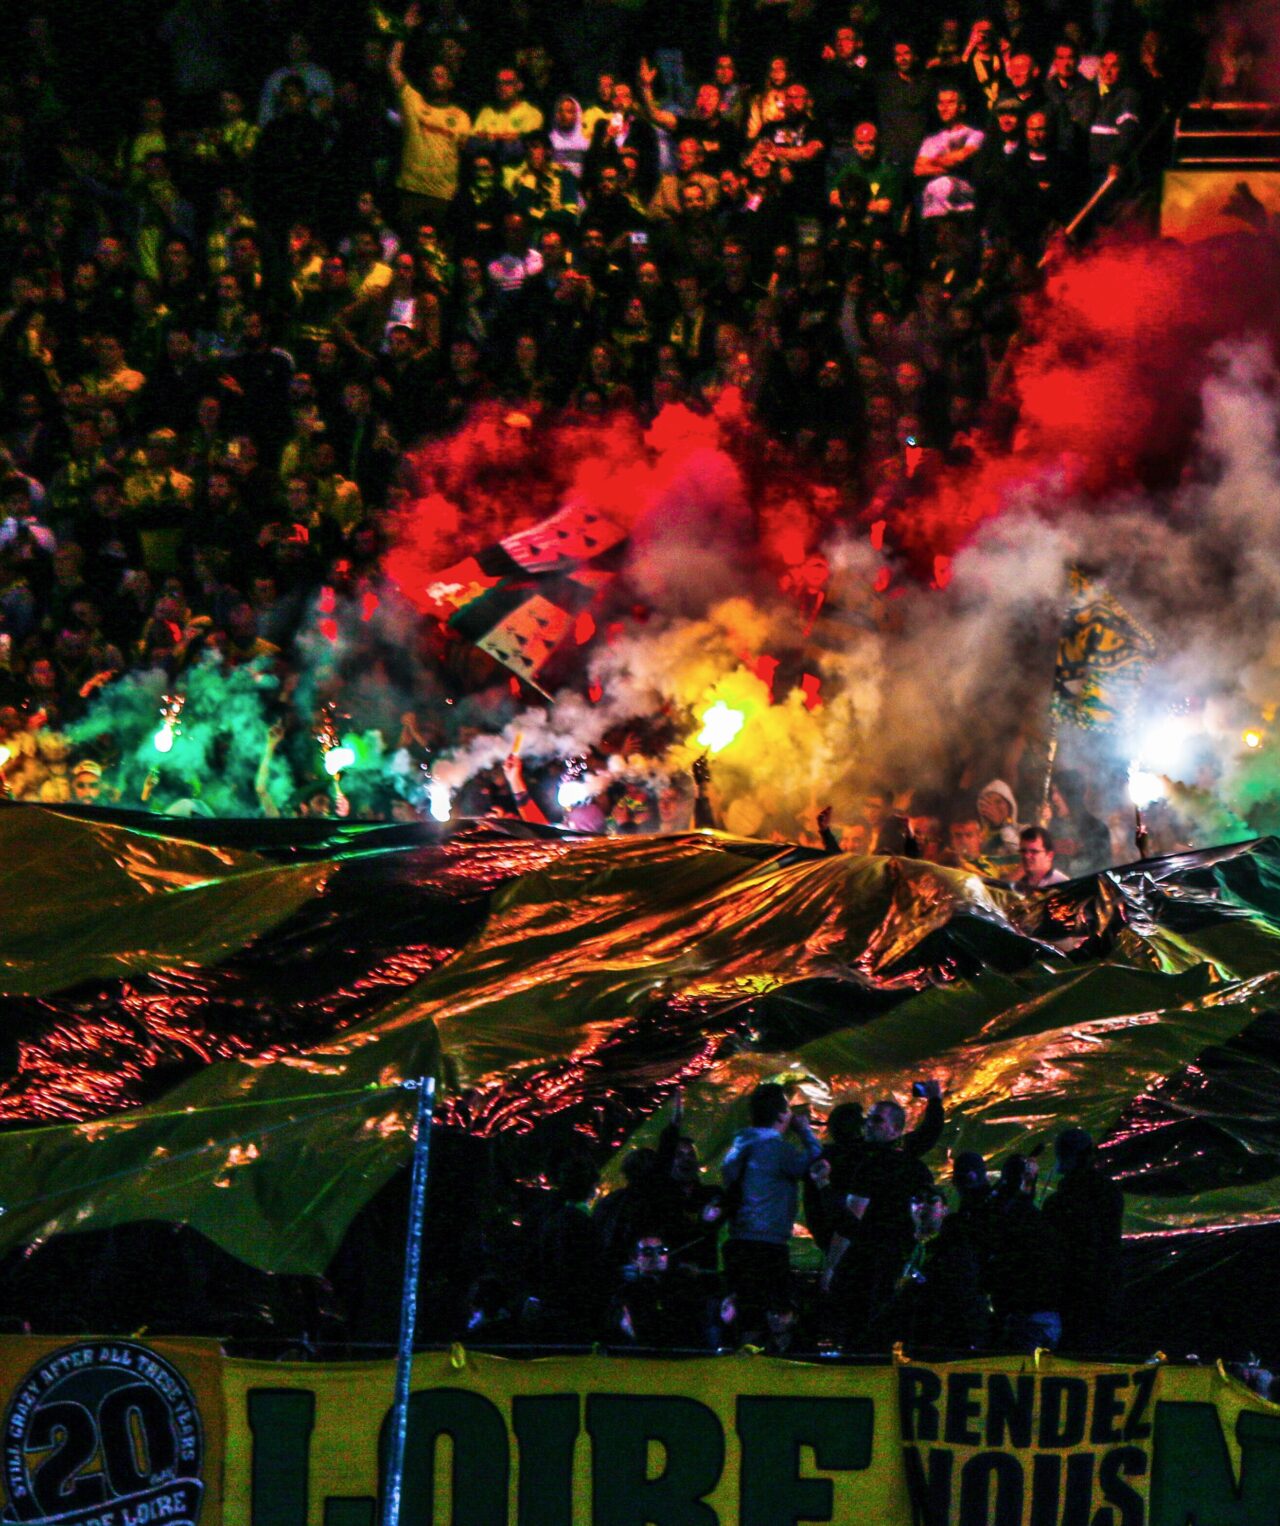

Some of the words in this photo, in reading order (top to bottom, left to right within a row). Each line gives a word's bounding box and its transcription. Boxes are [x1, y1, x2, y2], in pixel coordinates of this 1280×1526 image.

[40, 1349, 94, 1385] AFTER
[99, 1348, 133, 1366] ALL
[137, 1355, 183, 1402] THESE
[9, 1379, 41, 1438] CRAZY
[175, 1401, 196, 1461] YEARS
[899, 1366, 1158, 1449] RENDEZ
[8, 1444, 27, 1498] STILL
[23, 1381, 178, 1514] 20
[246, 1387, 875, 1526] LOIRE
[901, 1446, 1149, 1526] VOUS
